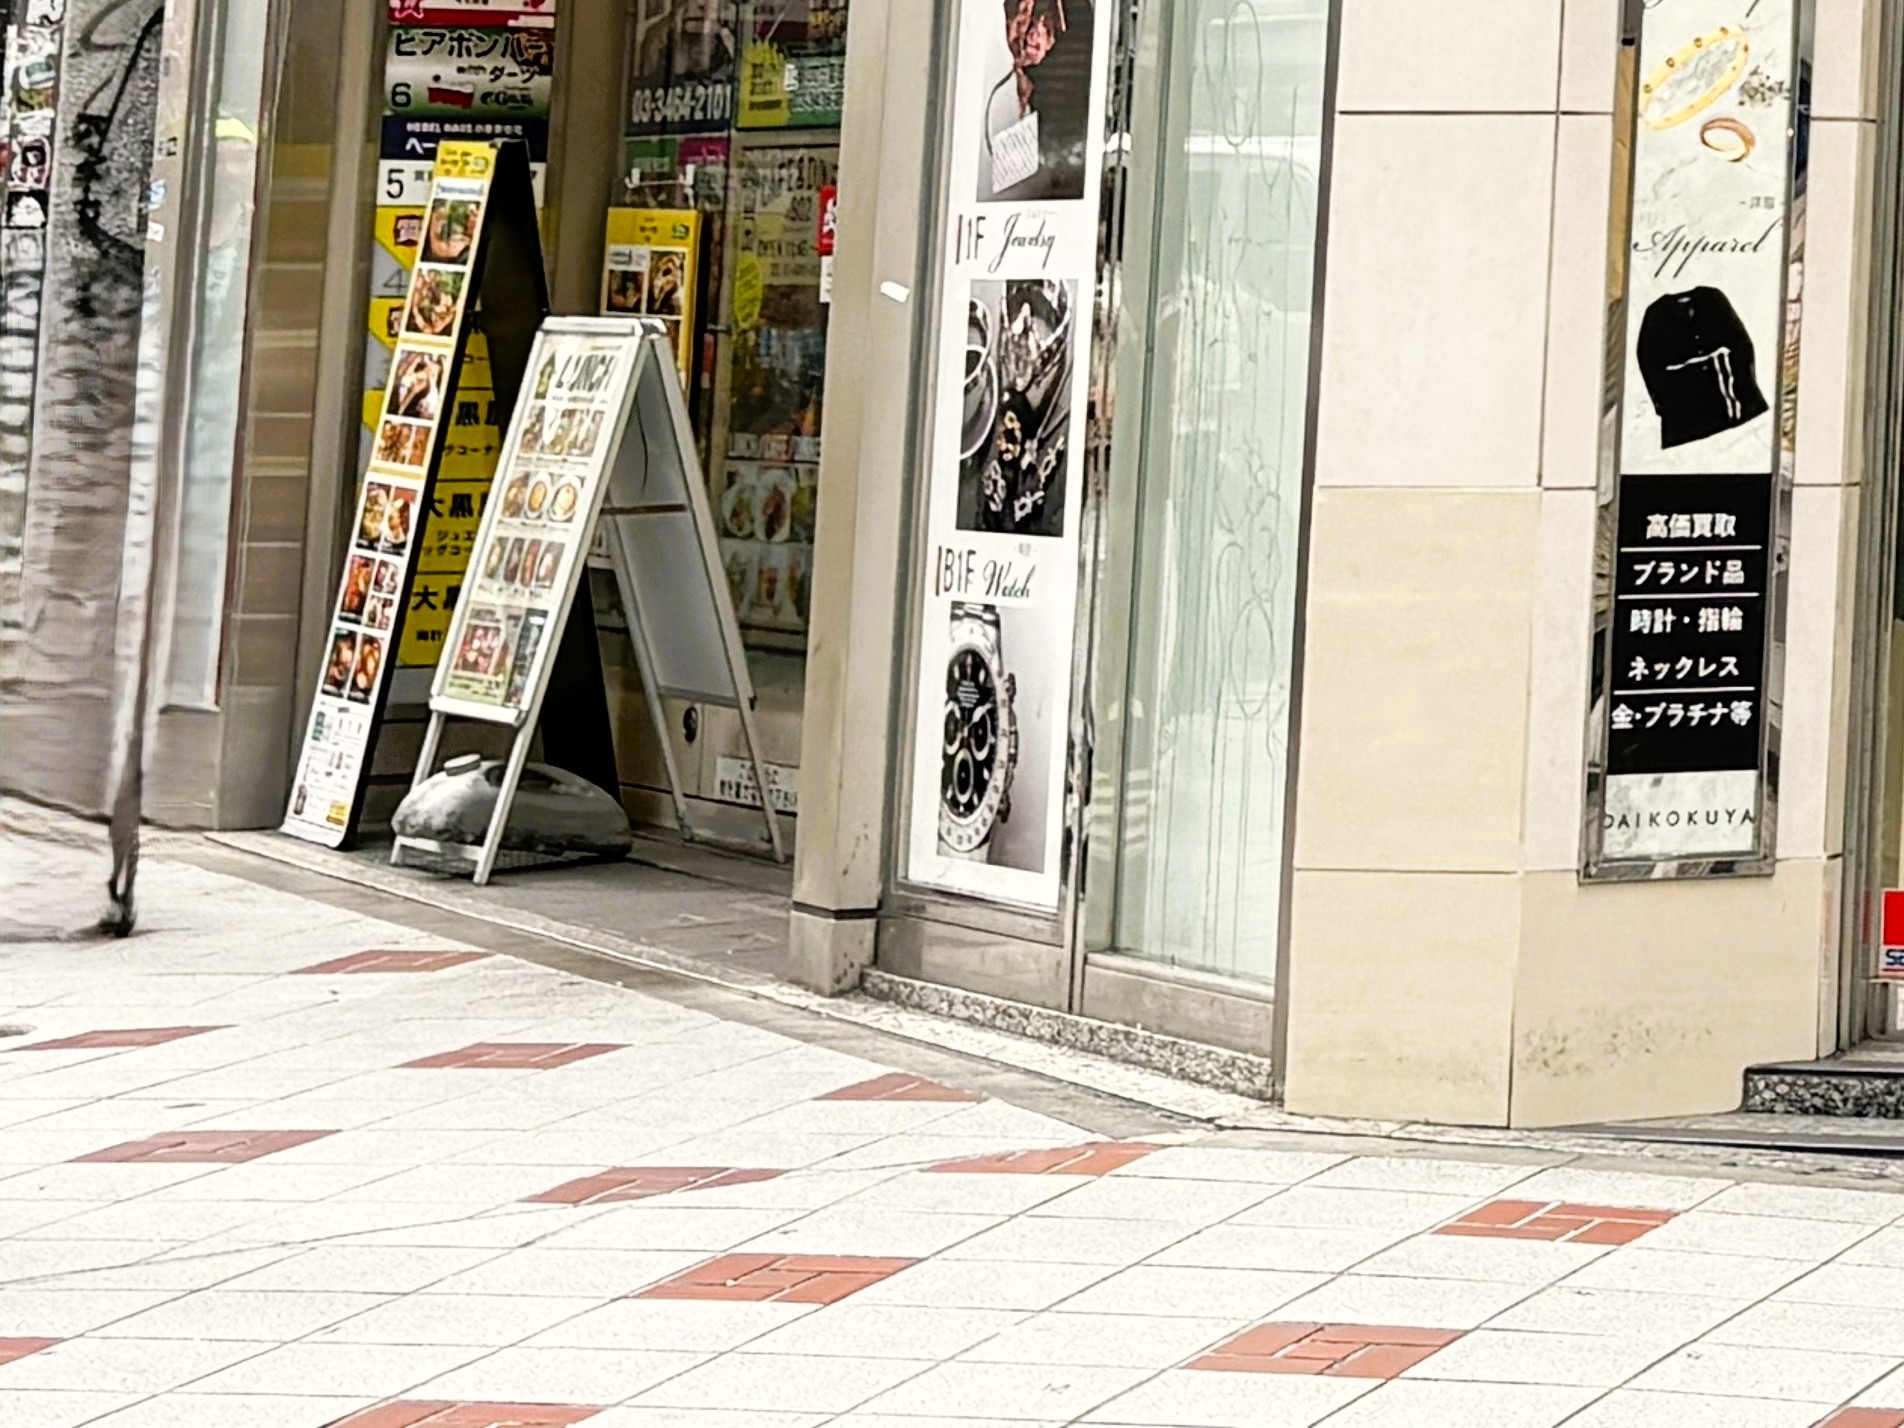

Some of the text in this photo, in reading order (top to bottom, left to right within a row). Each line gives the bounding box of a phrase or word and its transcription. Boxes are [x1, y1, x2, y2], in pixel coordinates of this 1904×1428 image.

[489, 65, 540, 84] ダーツ
[391, 82, 412, 109] 6
[385, 168, 405, 200] 5
[988, 211, 1056, 271] Jewelry
[1632, 217, 1786, 278] Apparel
[1645, 512, 1738, 539] 高価買取
[942, 547, 1032, 601] B1F Watch
[1632, 560, 1746, 585] ブランド品
[1629, 606, 1745, 634] 時計・指輪
[1627, 654, 1740, 682] ネックレス
[1610, 700, 1754, 730] 金・プラチナ等
[1603, 808, 1756, 830] DAIKOKUYA
